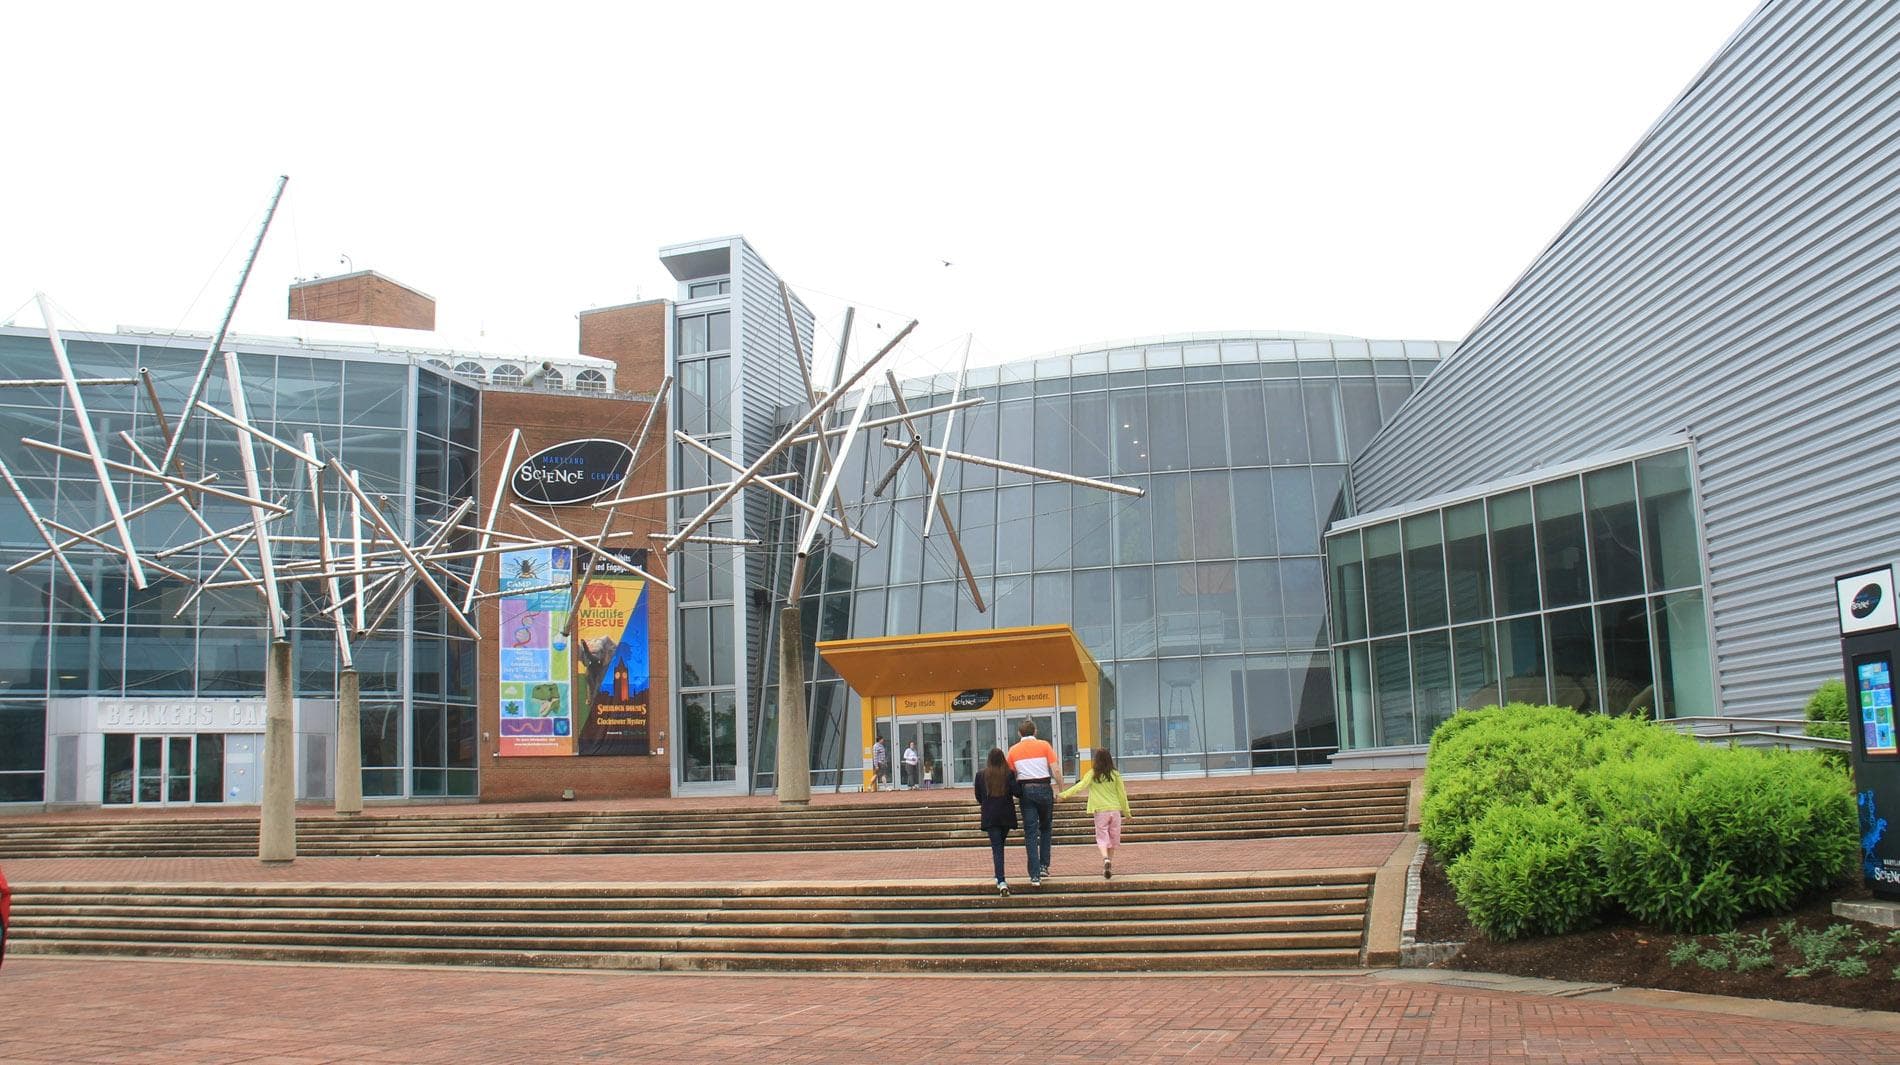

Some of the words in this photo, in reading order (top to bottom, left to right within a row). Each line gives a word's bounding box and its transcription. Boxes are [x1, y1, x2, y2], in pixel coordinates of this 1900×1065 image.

[543, 456, 584, 465] MARYLAND
[591, 471, 621, 480] CENTER
[580, 609, 624, 618] Wildlife
[580, 618, 624, 627] RESCUE
[1008, 693, 1025, 701] Touch
[904, 700, 917, 708] Step
[919, 699, 936, 707] inside
[107, 704, 214, 726] BEAKERS
